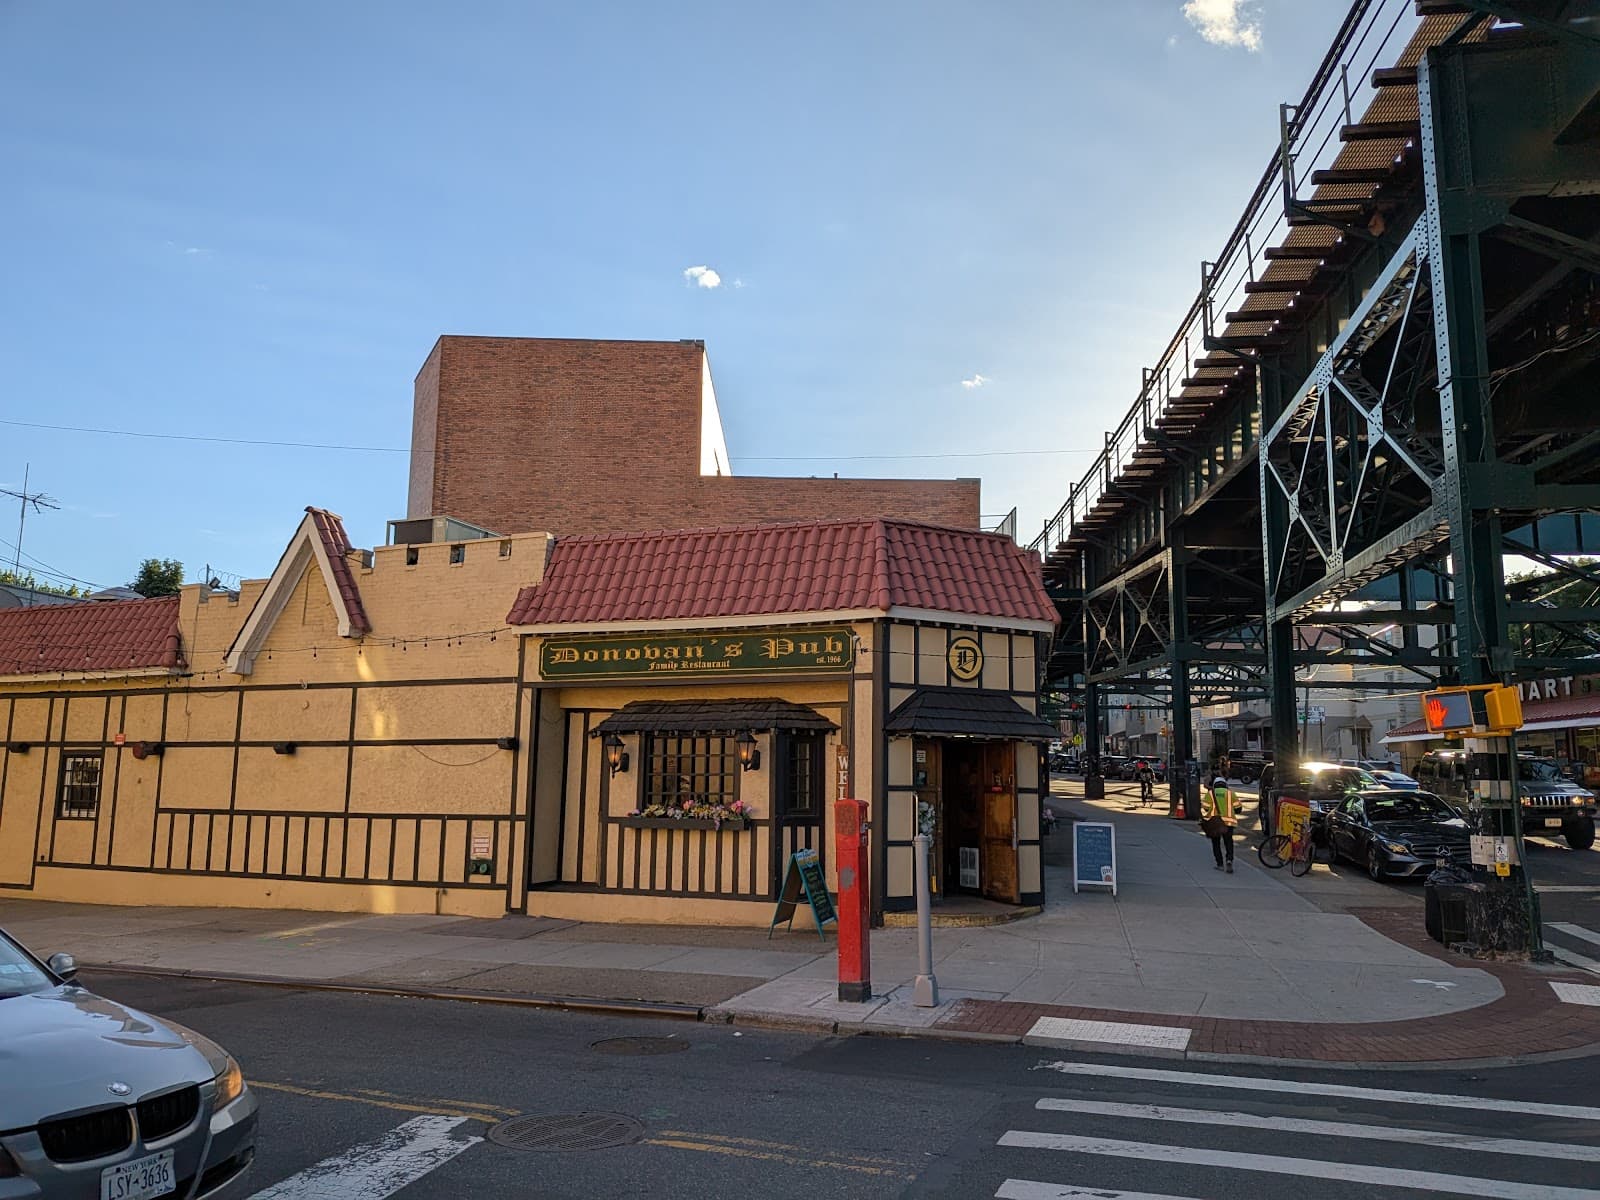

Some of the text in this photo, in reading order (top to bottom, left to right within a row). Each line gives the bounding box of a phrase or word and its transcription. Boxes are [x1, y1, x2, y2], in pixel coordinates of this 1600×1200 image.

[549, 636, 843, 665] Donovan's Pub
[648, 658, 731, 671] Family Restaurant
[954, 644, 978, 674] D
[837, 755, 849, 801] WEL
